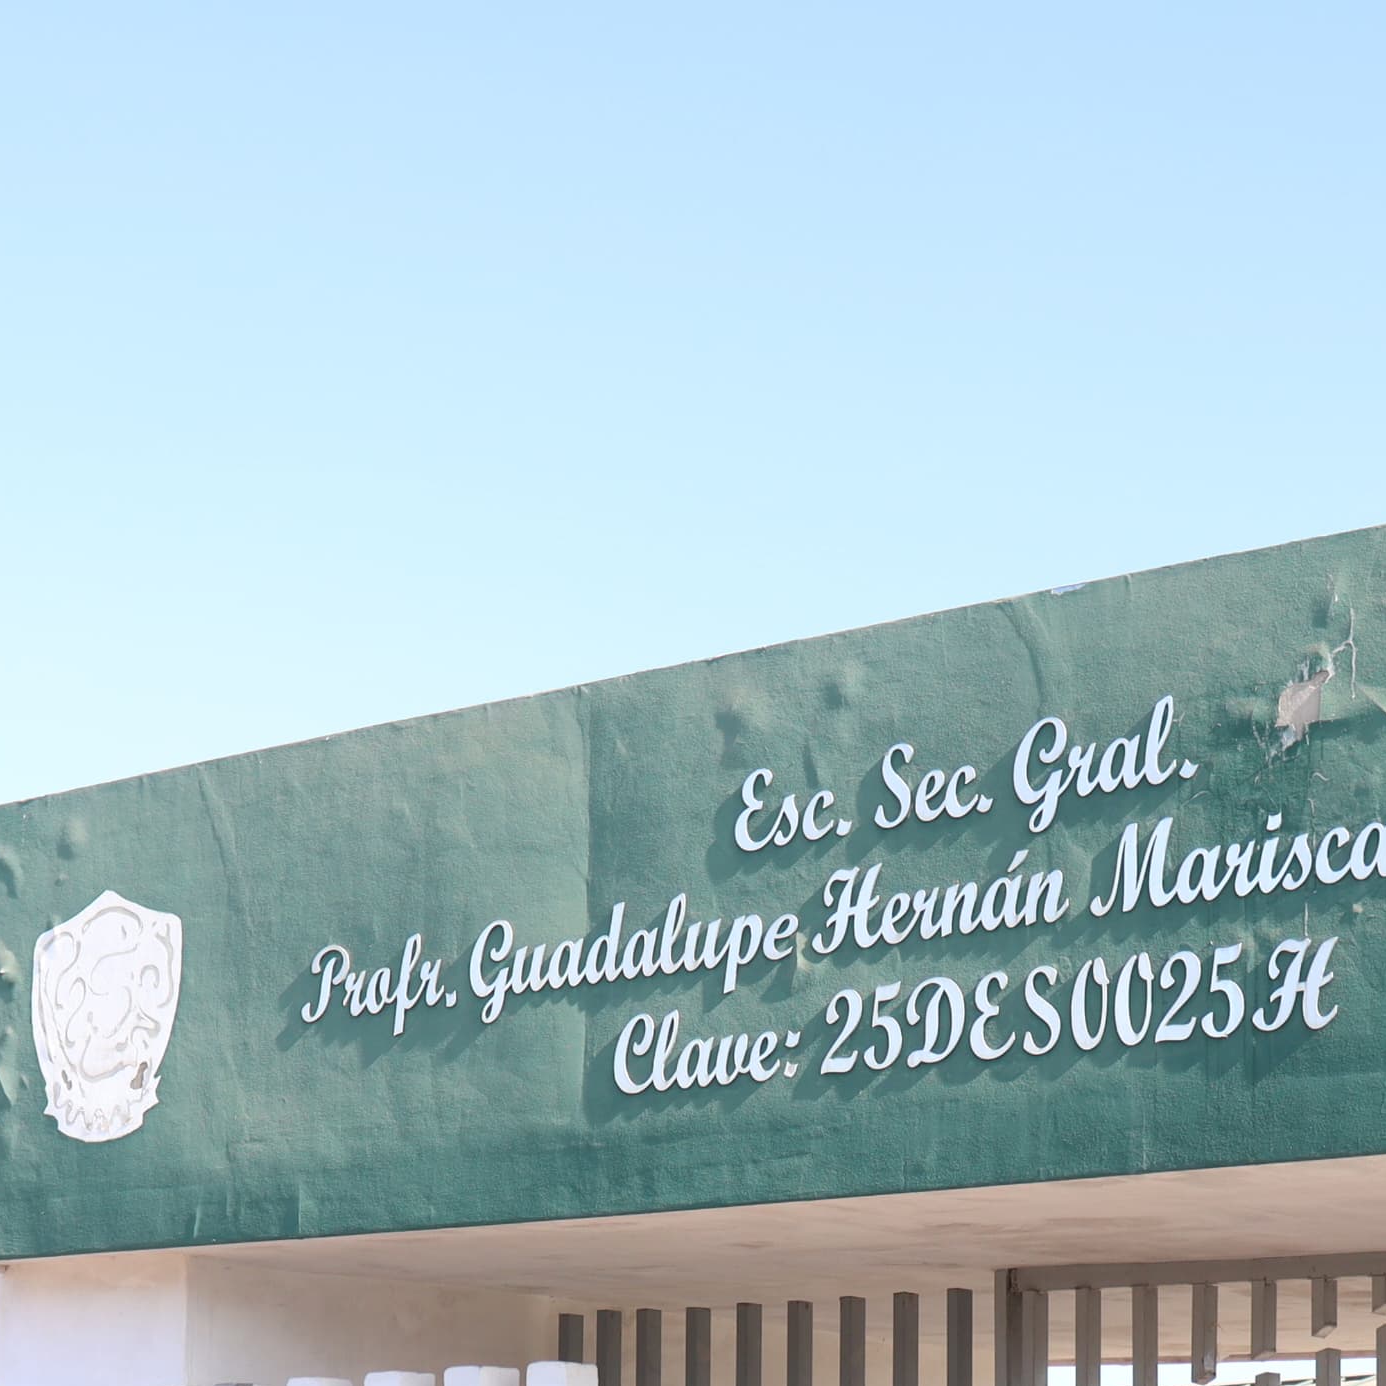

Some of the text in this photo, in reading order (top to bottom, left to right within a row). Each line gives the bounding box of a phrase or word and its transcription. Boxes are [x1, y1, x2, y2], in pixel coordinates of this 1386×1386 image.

[735, 695, 1199, 853] Esc. Sec. Gral.
[301, 934, 457, 1036] Profr.
[470, 893, 799, 1023] Guadalupe
[813, 850, 1069, 954] Hernán
[613, 1010, 800, 1094] Clave:
